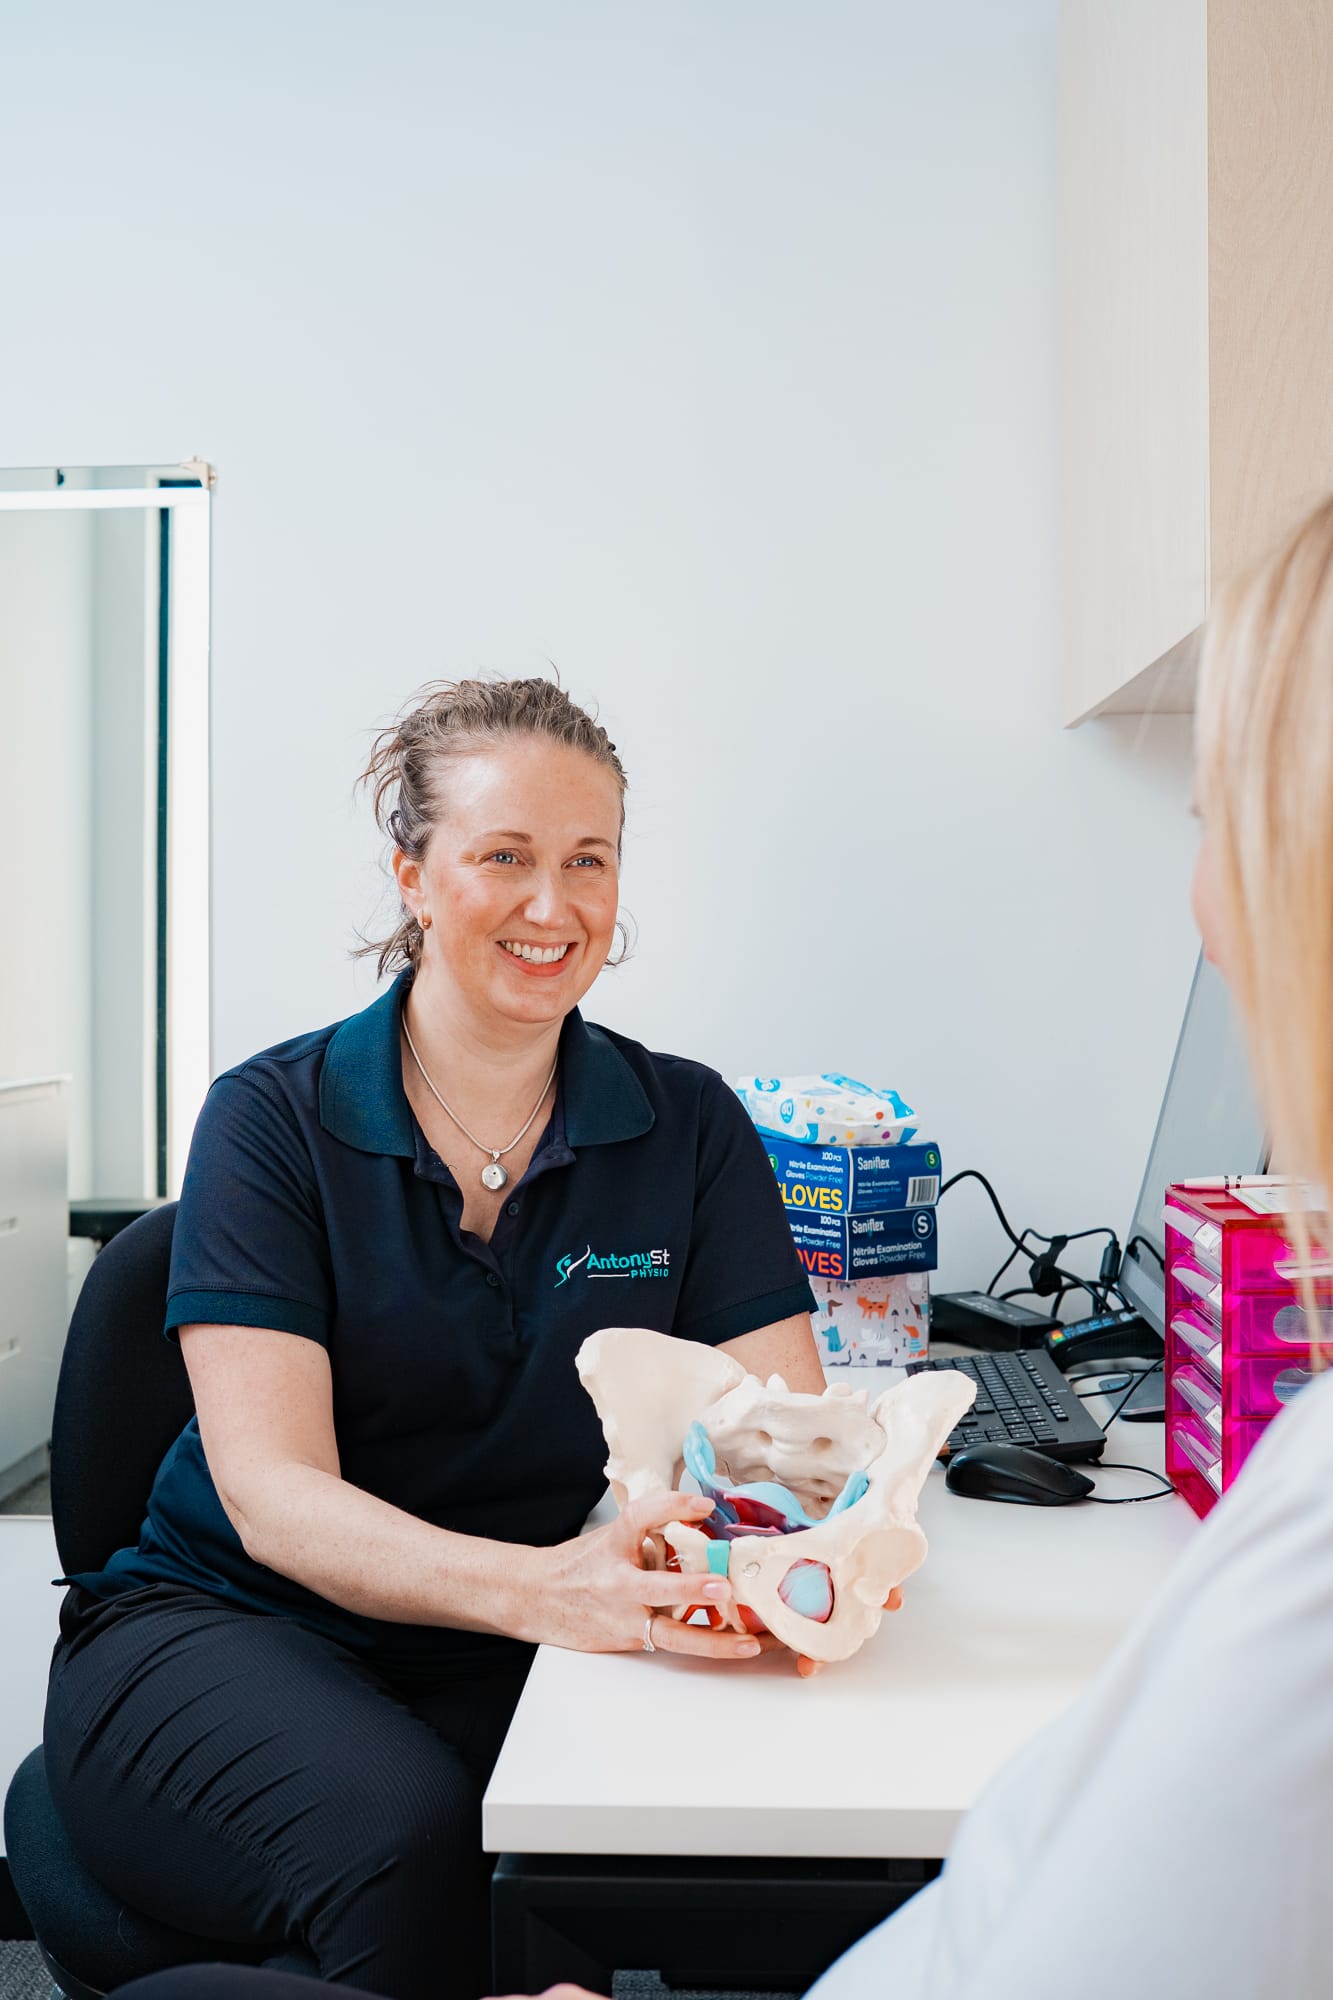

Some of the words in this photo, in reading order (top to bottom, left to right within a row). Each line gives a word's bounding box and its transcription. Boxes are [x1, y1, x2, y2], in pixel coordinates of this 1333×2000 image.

[857, 1155, 890, 1171] Saniflex
[929, 1153, 936, 1165] S
[806, 1162, 844, 1173] Examination
[786, 1169, 805, 1179] Gloves
[805, 1172, 827, 1182] Powder
[828, 1174, 843, 1184] Free
[778, 1182, 843, 1211] LOVES
[803, 1225, 842, 1238] Examination
[852, 1218, 885, 1234] Saniflex
[917, 1215, 928, 1234] S
[802, 1235, 825, 1246] Powder
[826, 1239, 841, 1249] Free
[853, 1245, 876, 1257] Nitrile
[876, 1241, 922, 1254] Examination
[853, 1257, 878, 1267] Gloves
[879, 1253, 907, 1263] Powder
[908, 1250, 926, 1260] Free
[630, 1268, 670, 1279] PHYSIO
